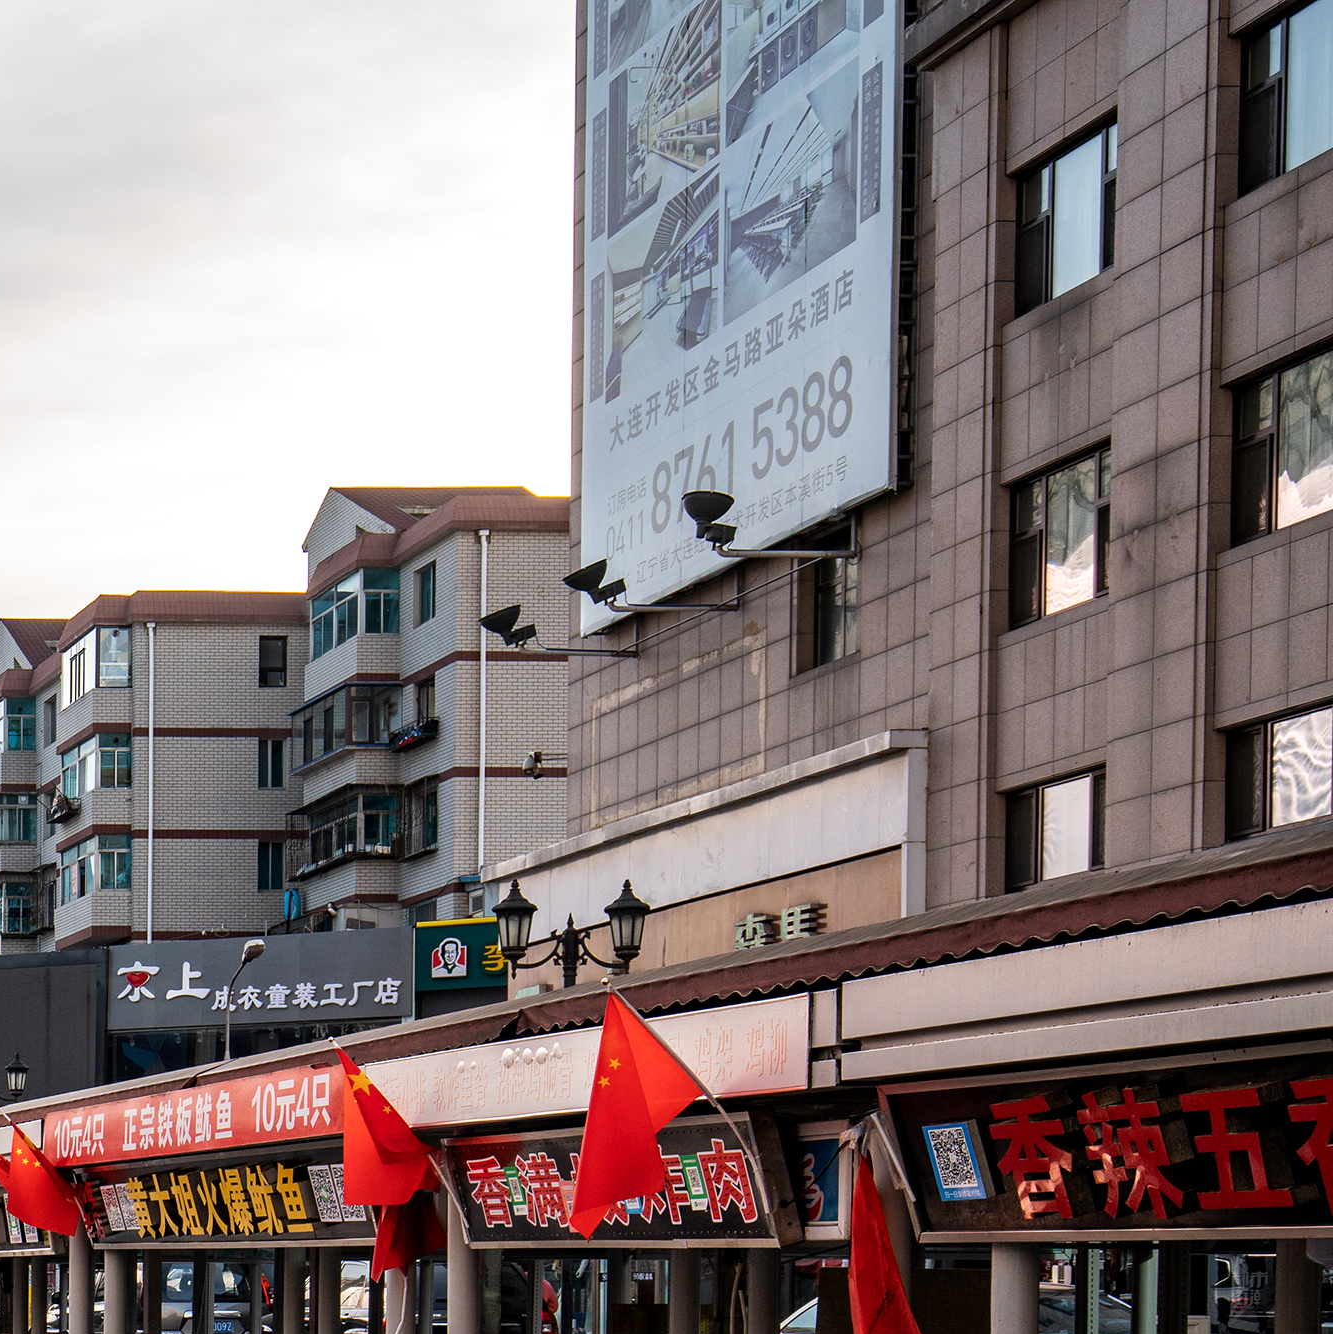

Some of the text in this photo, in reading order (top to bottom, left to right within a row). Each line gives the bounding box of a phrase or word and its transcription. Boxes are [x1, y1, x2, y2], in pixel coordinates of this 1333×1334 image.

[609, 269, 855, 452] 大连开发区金马路亚朵酒店
[606, 356, 854, 561] 0411 8761 5388
[211, 977, 403, 1012] 成衣童装工厂店
[54, 1073, 332, 1159] 10元4只 正宗铁板鱿鱼 10元4只
[126, 1162, 314, 1240] 黄大姐火爆鱿鱼
[467, 1137, 759, 1229] 香满炸肉
